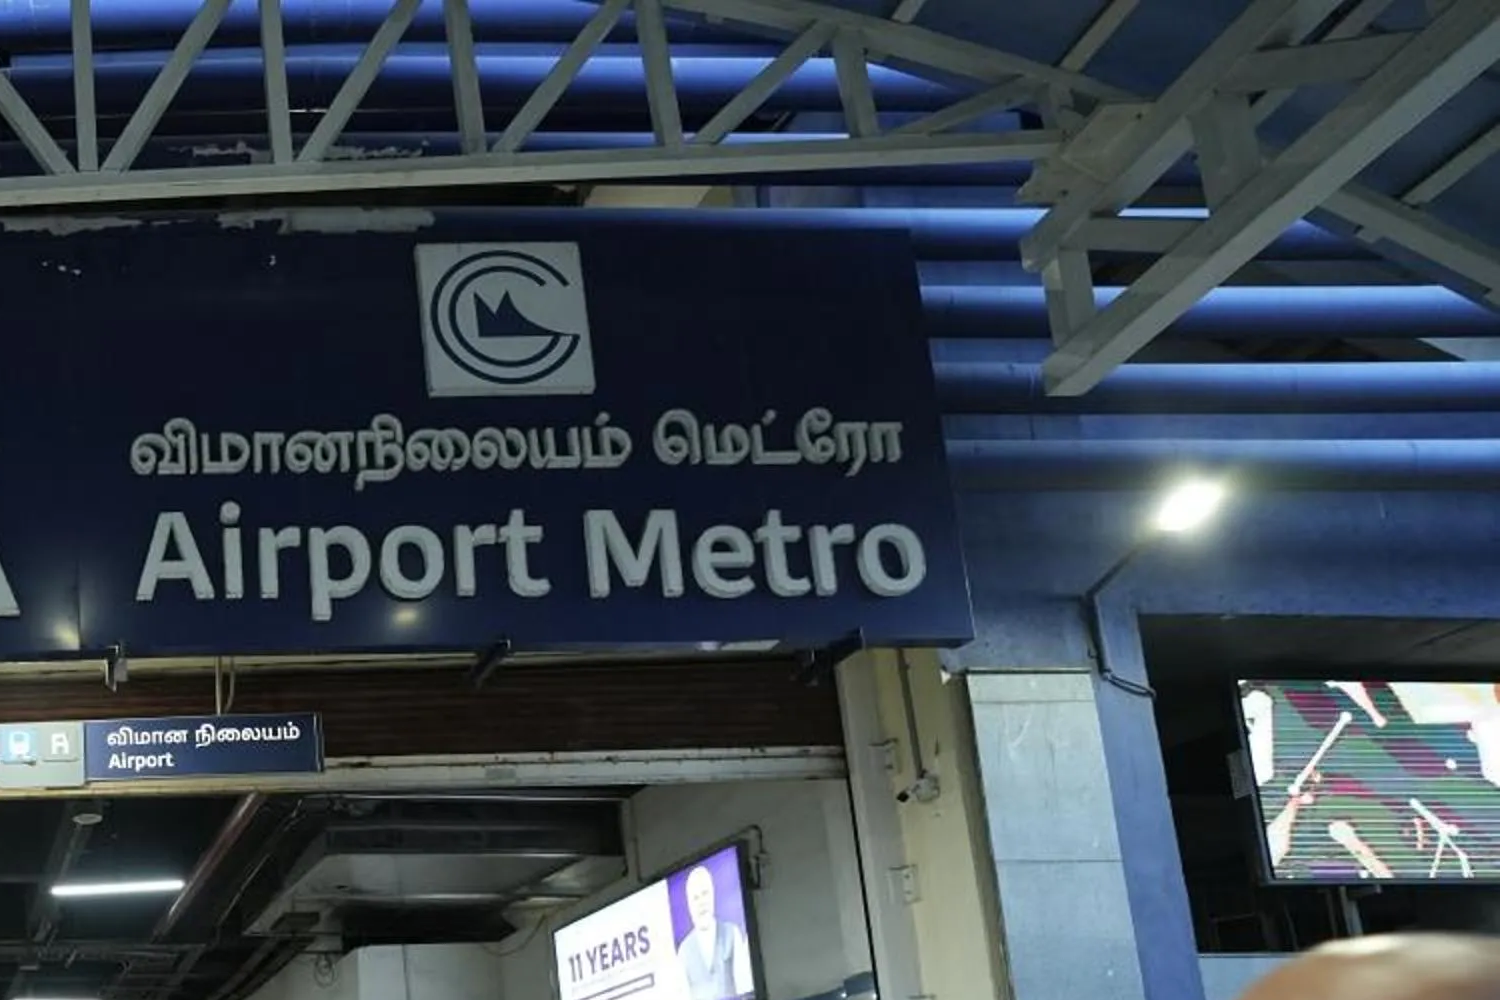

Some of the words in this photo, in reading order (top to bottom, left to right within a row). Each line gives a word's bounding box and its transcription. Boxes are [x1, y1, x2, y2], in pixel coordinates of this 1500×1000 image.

[130, 412, 632, 491] விமானநிலையம்
[652, 408, 902, 477] மெட்ரோ
[135, 501, 551, 621] Airport
[583, 508, 927, 600] Metro
[107, 726, 188, 747] விமான
[195, 721, 300, 748] நிலையம்
[108, 752, 174, 772] Airport
[568, 952, 583, 983] 11
[585, 925, 651, 976] YEARS
